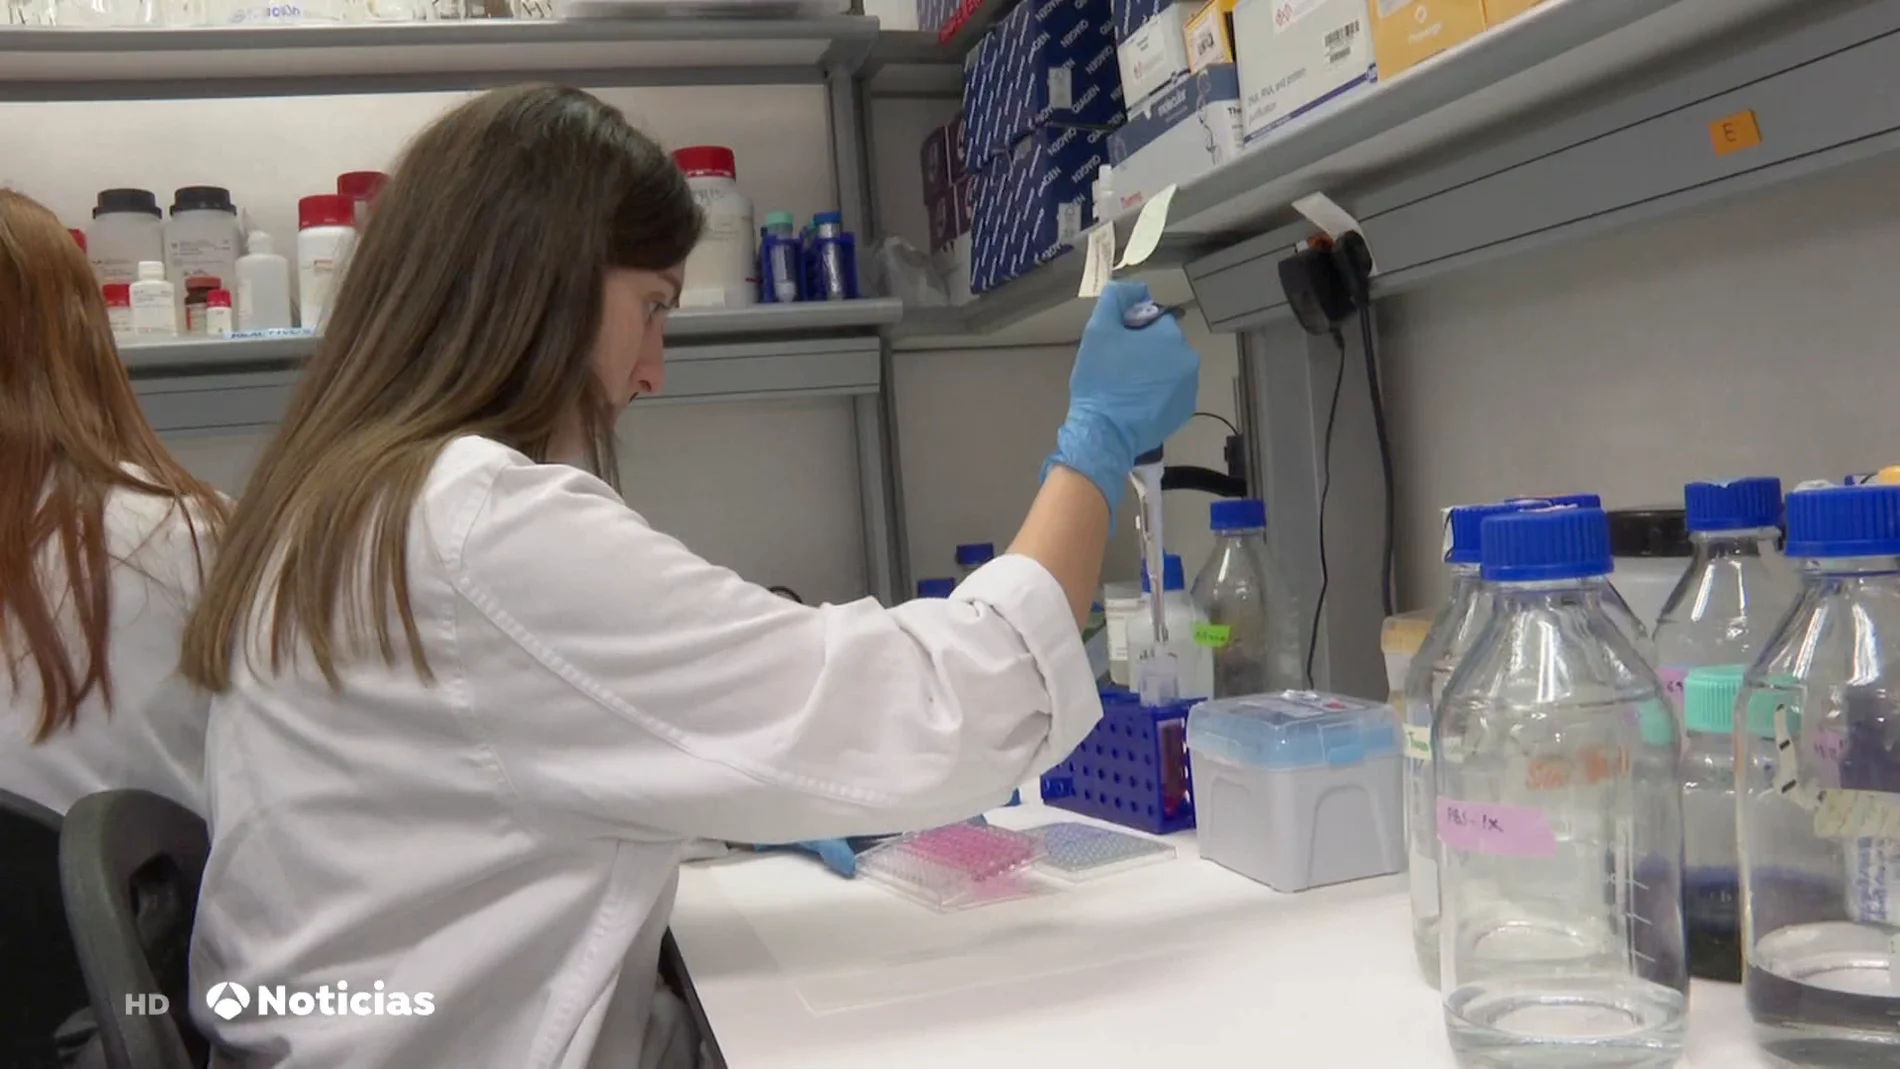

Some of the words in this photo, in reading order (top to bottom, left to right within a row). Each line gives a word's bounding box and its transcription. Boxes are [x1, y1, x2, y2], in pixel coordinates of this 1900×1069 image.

[1060, 19, 1089, 48] QIAGEN
[1072, 84, 1101, 114] QIAGEN
[1047, 127, 1077, 157] QIAGEN
[1722, 122, 1738, 143] E
[1071, 154, 1101, 184] QIAGEN
